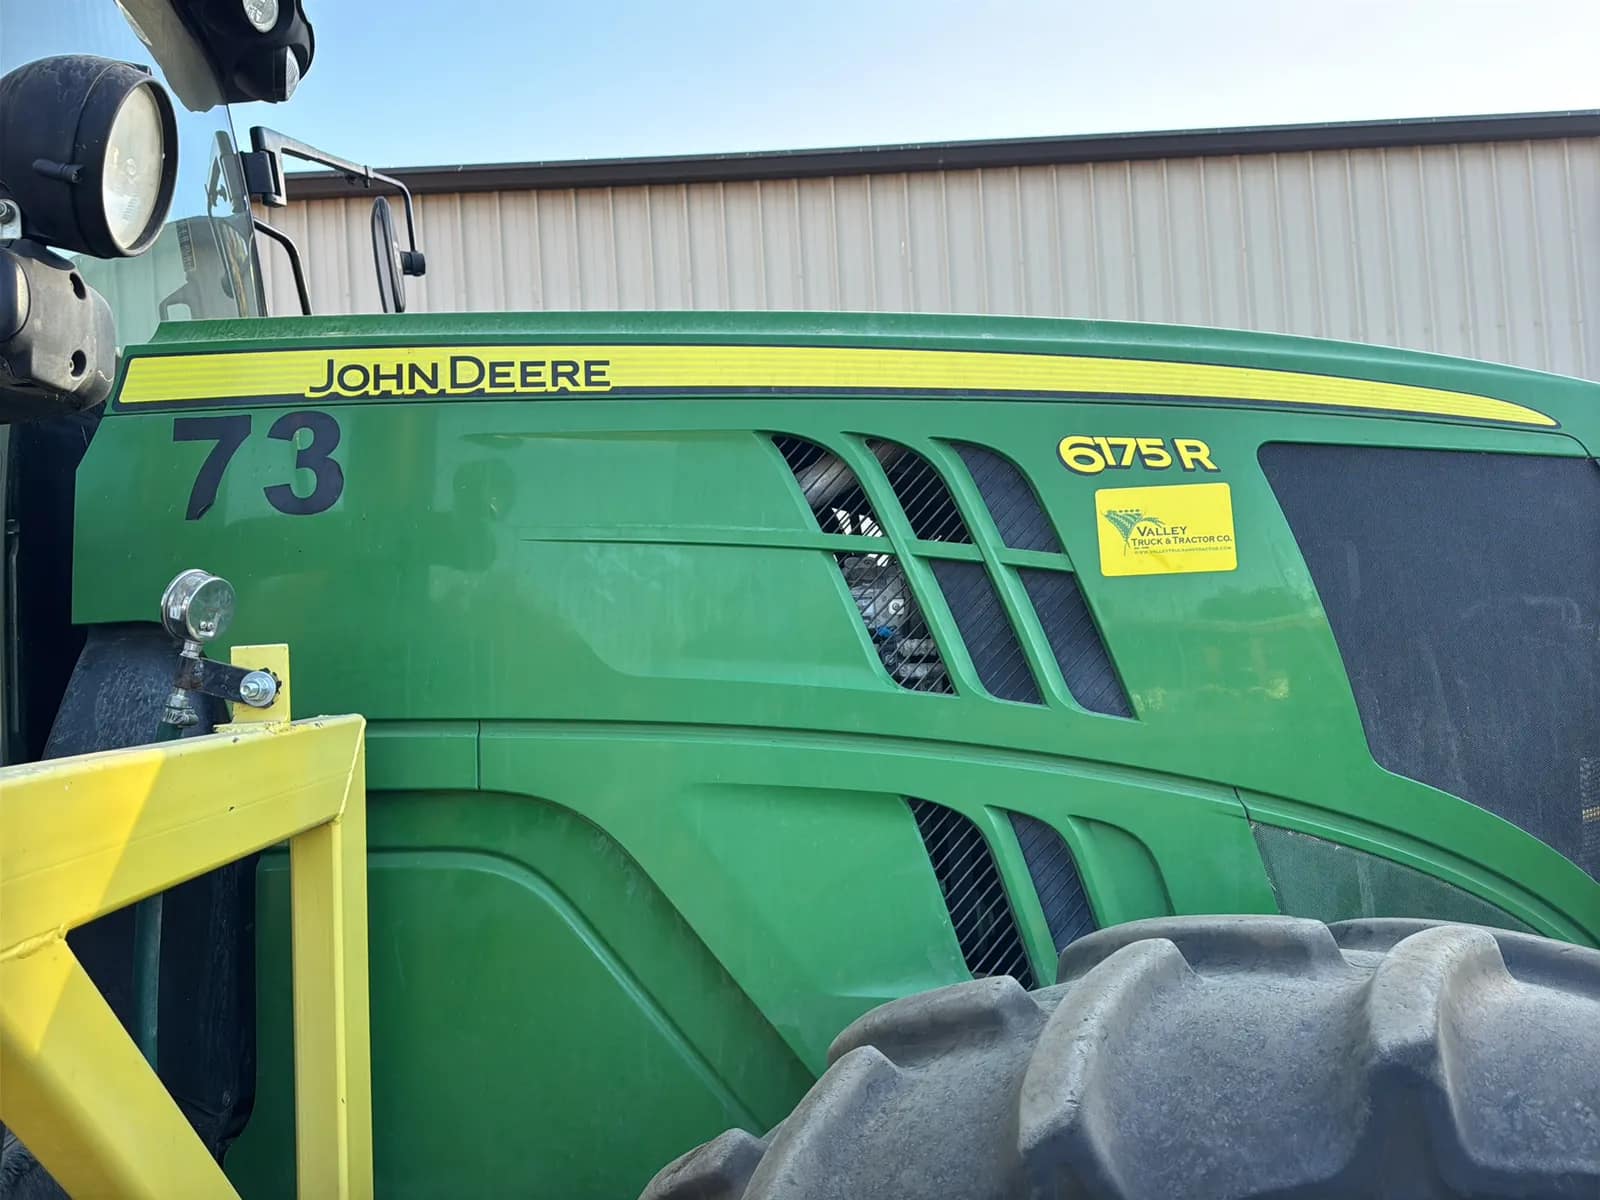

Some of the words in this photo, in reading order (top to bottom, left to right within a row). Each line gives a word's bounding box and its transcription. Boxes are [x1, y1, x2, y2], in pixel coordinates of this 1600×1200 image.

[308, 358, 439, 393] JOHN
[450, 355, 611, 390] DEERE
[173, 411, 344, 520] 73
[1131, 537, 1163, 546] TRUCK
[1165, 537, 1171, 545] &
[1172, 534, 1215, 544] TRACTOR
[1136, 526, 1187, 536] VALLEY
